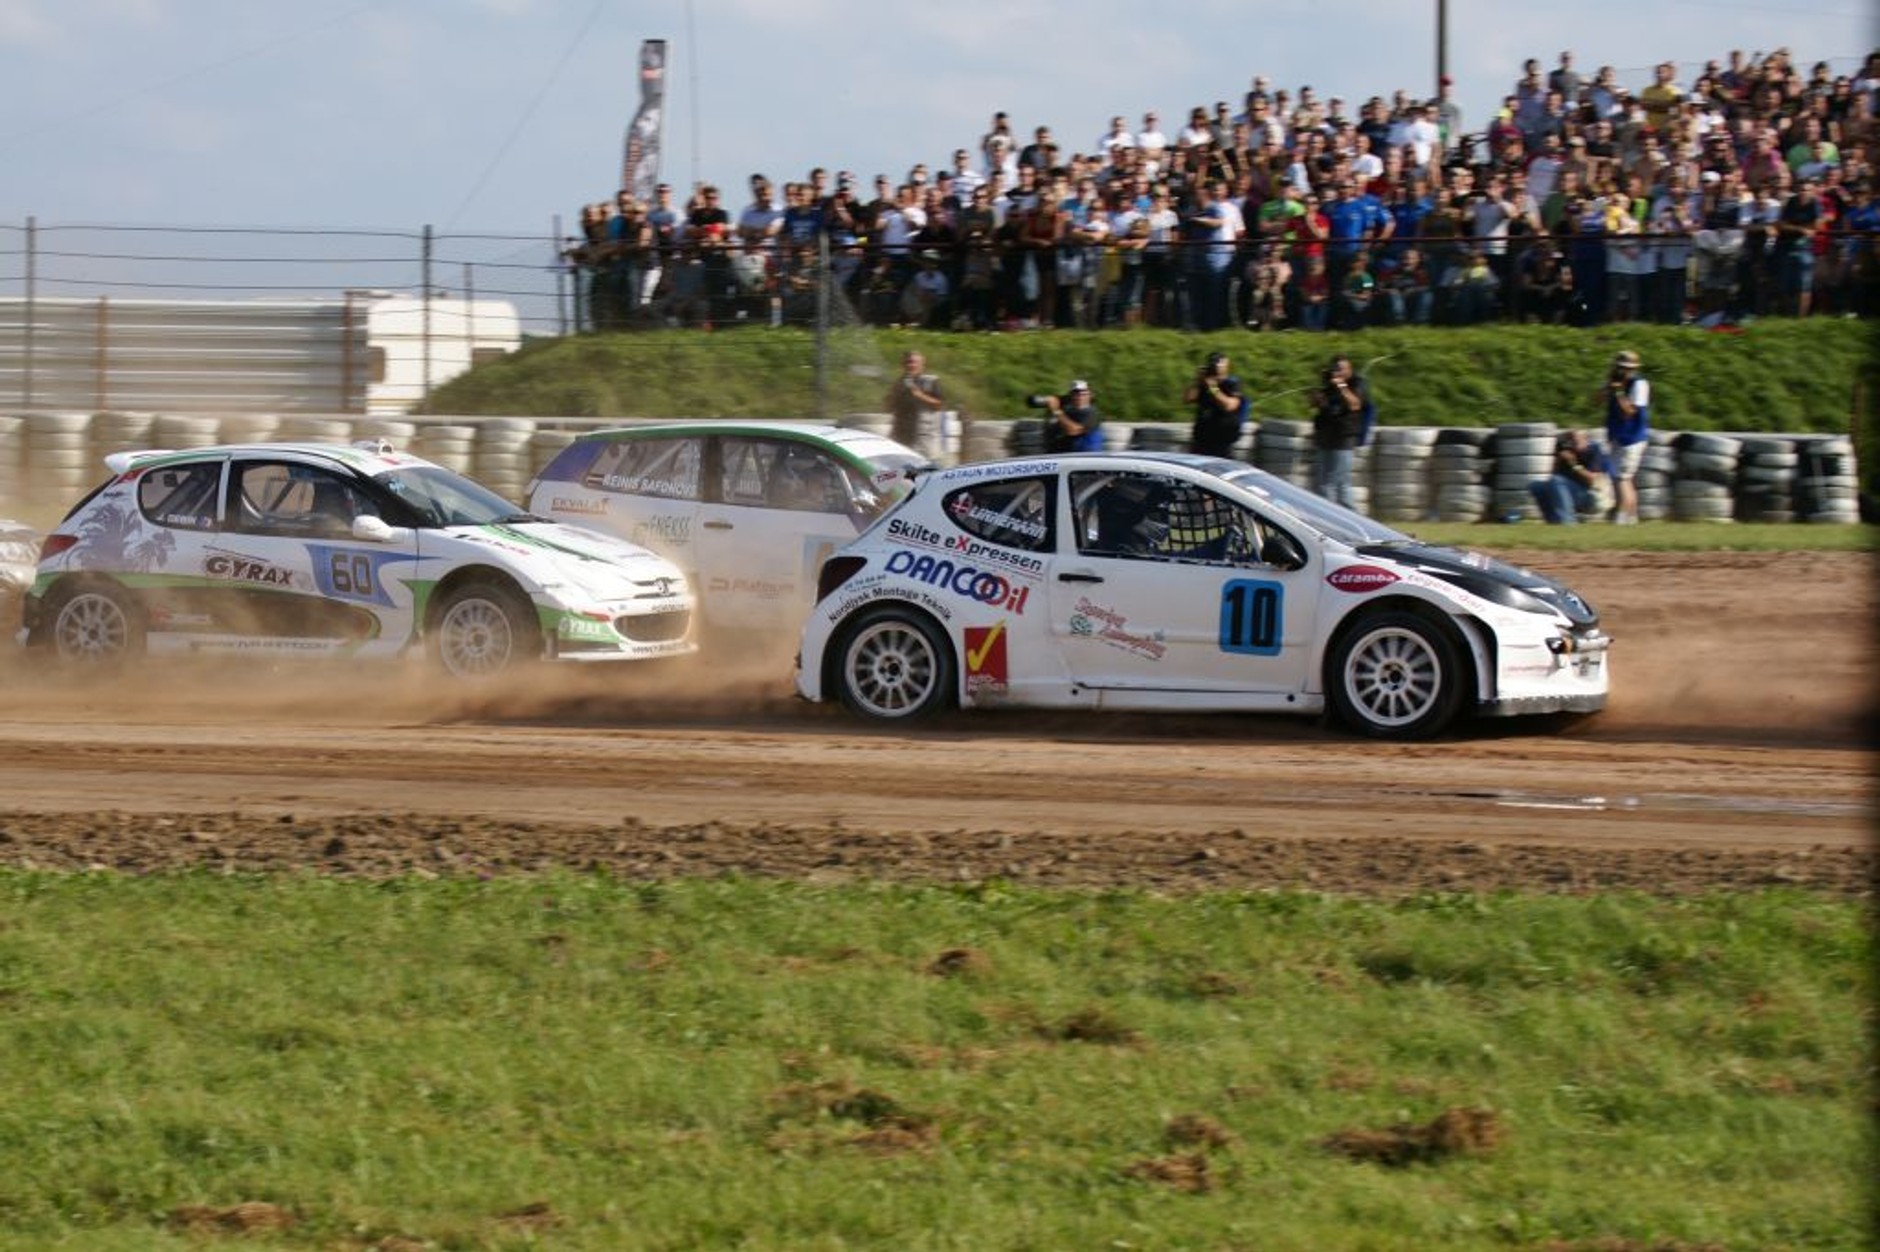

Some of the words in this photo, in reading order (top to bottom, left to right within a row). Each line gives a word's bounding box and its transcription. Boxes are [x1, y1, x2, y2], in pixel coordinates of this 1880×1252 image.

[985, 462, 1059, 476] MOTORSPORT
[888, 519, 940, 545] Skilte
[945, 535, 1042, 573] eXpressen
[205, 556, 294, 586] GYRAX
[331, 554, 373, 596] 60
[1331, 572, 1395, 584] caramba
[872, 586, 919, 601] Montage
[921, 593, 952, 621] Teknik
[1224, 586, 1277, 648] 10
